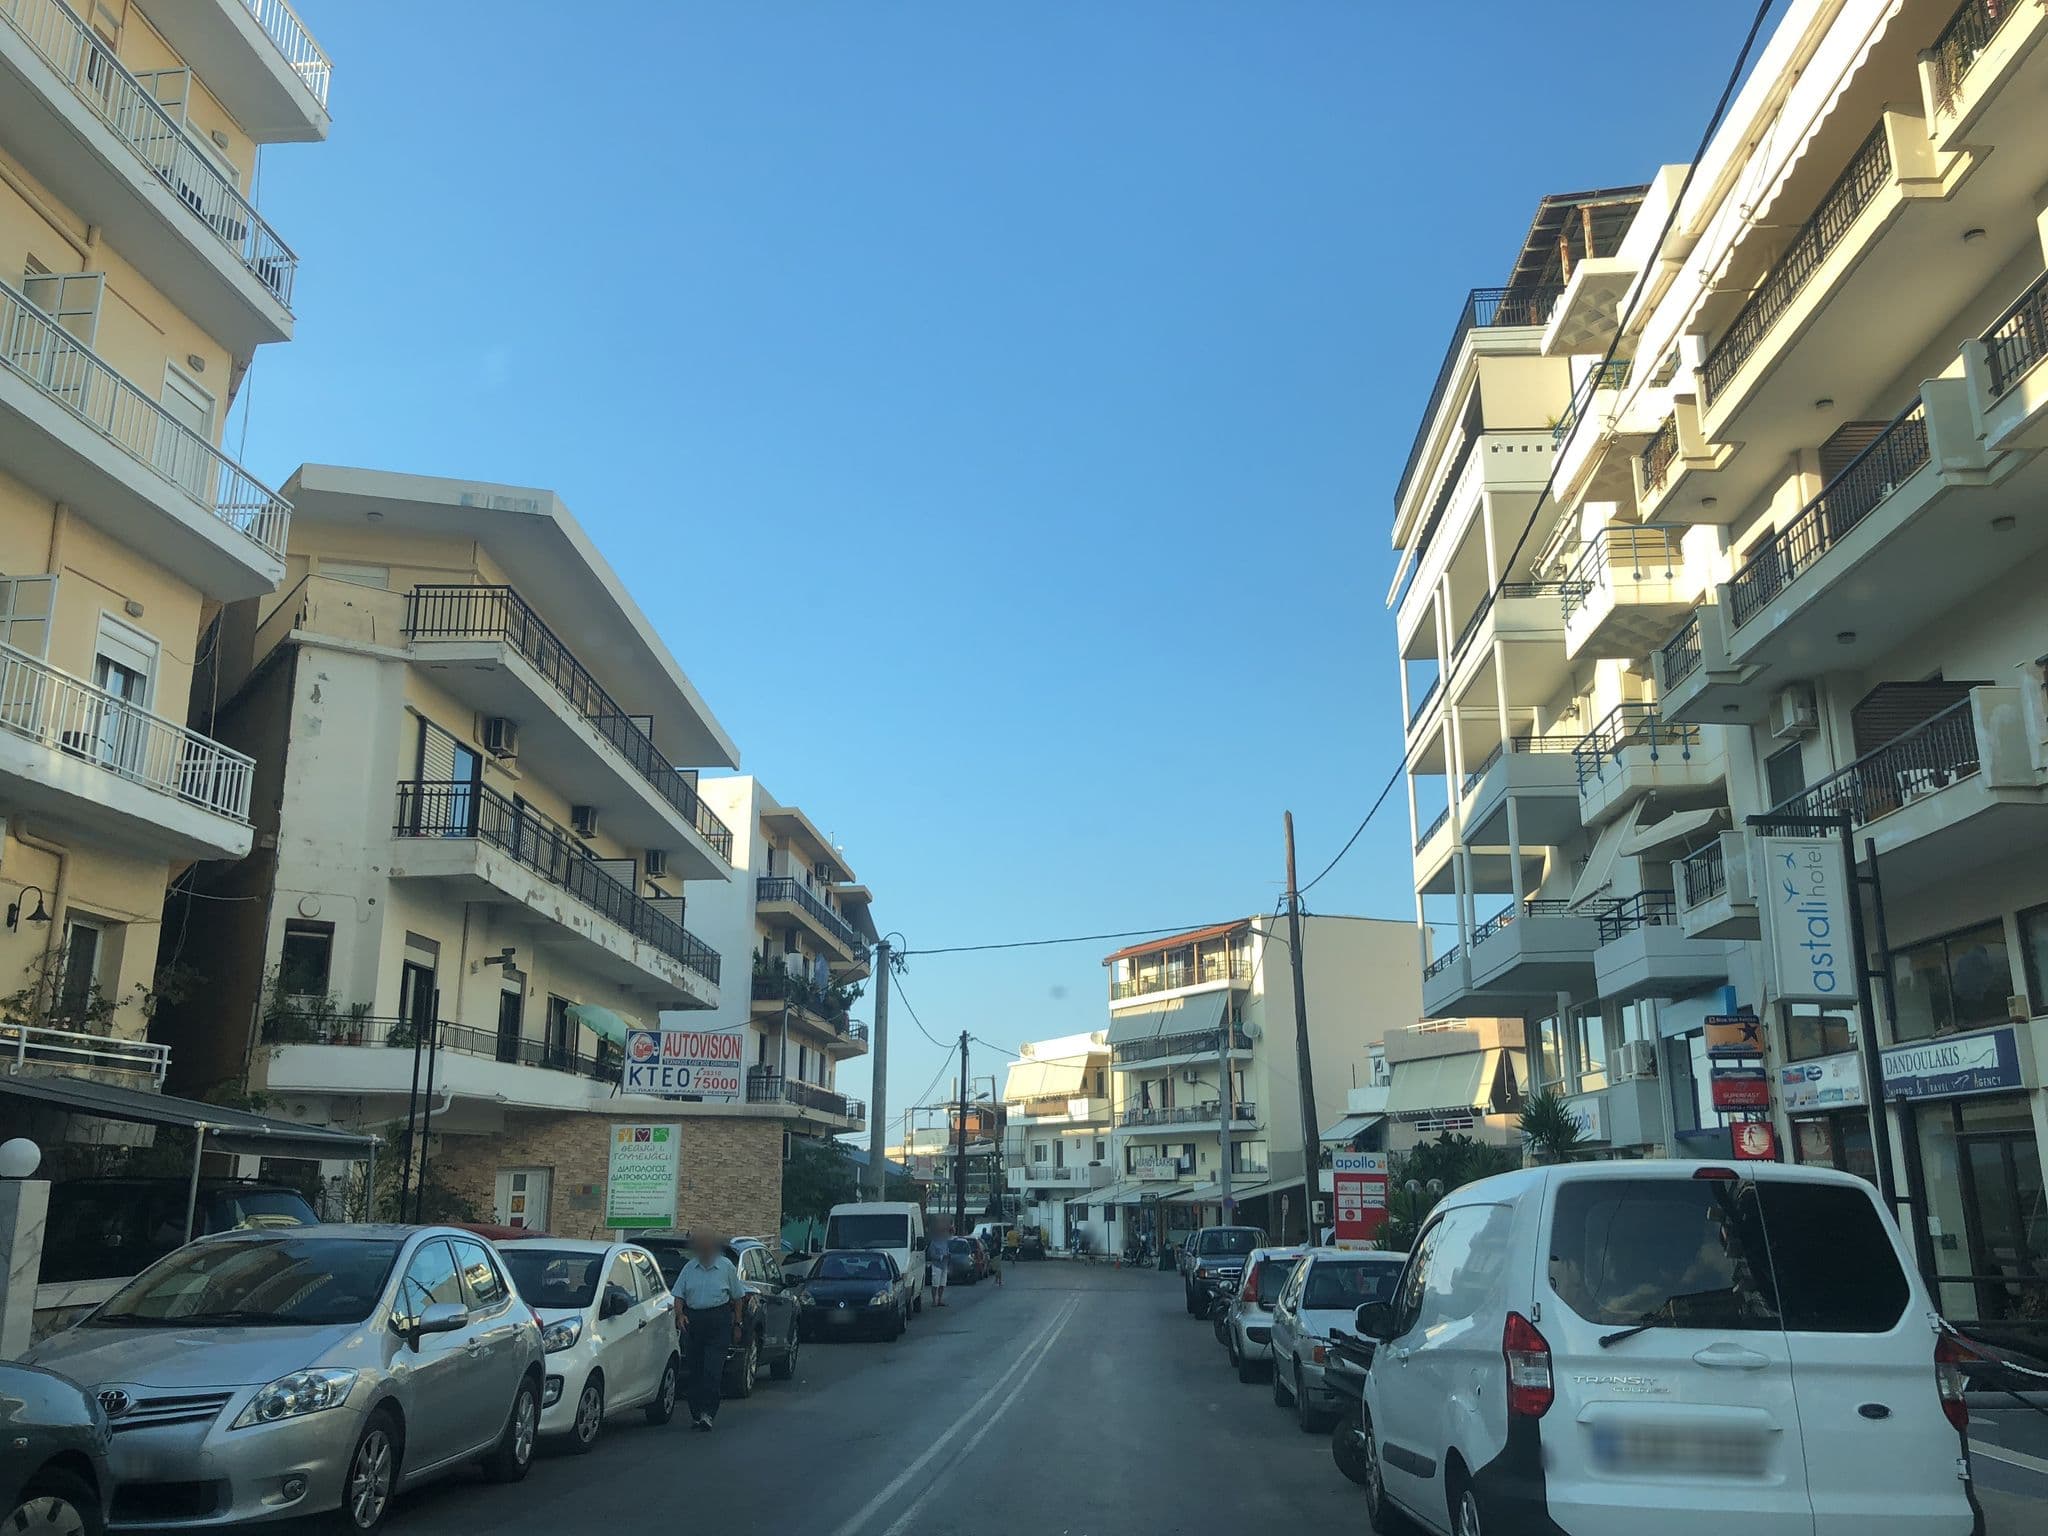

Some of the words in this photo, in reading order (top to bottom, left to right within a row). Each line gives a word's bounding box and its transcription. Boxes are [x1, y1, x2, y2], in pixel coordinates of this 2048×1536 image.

[1801, 846, 1825, 897] hotel
[1796, 901, 1836, 993] astali
[663, 1033, 740, 1060] AUTOVISION
[1885, 1045, 1960, 1075] DANDOULAKIS
[693, 1076, 738, 1090] 75000
[1926, 1078, 1949, 1093] TRAVEL
[1974, 1072, 2001, 1089] AGENCY
[617, 1165, 667, 1173] ΔΙΑΙΤΟΛΟΓΟΣ
[1336, 1155, 1376, 1170] apollo
[611, 1173, 673, 1181] ΔΙΑΤΡΟΦΟΛΟΓΟΣ
[1573, 1375, 1657, 1386] TRANSIT
